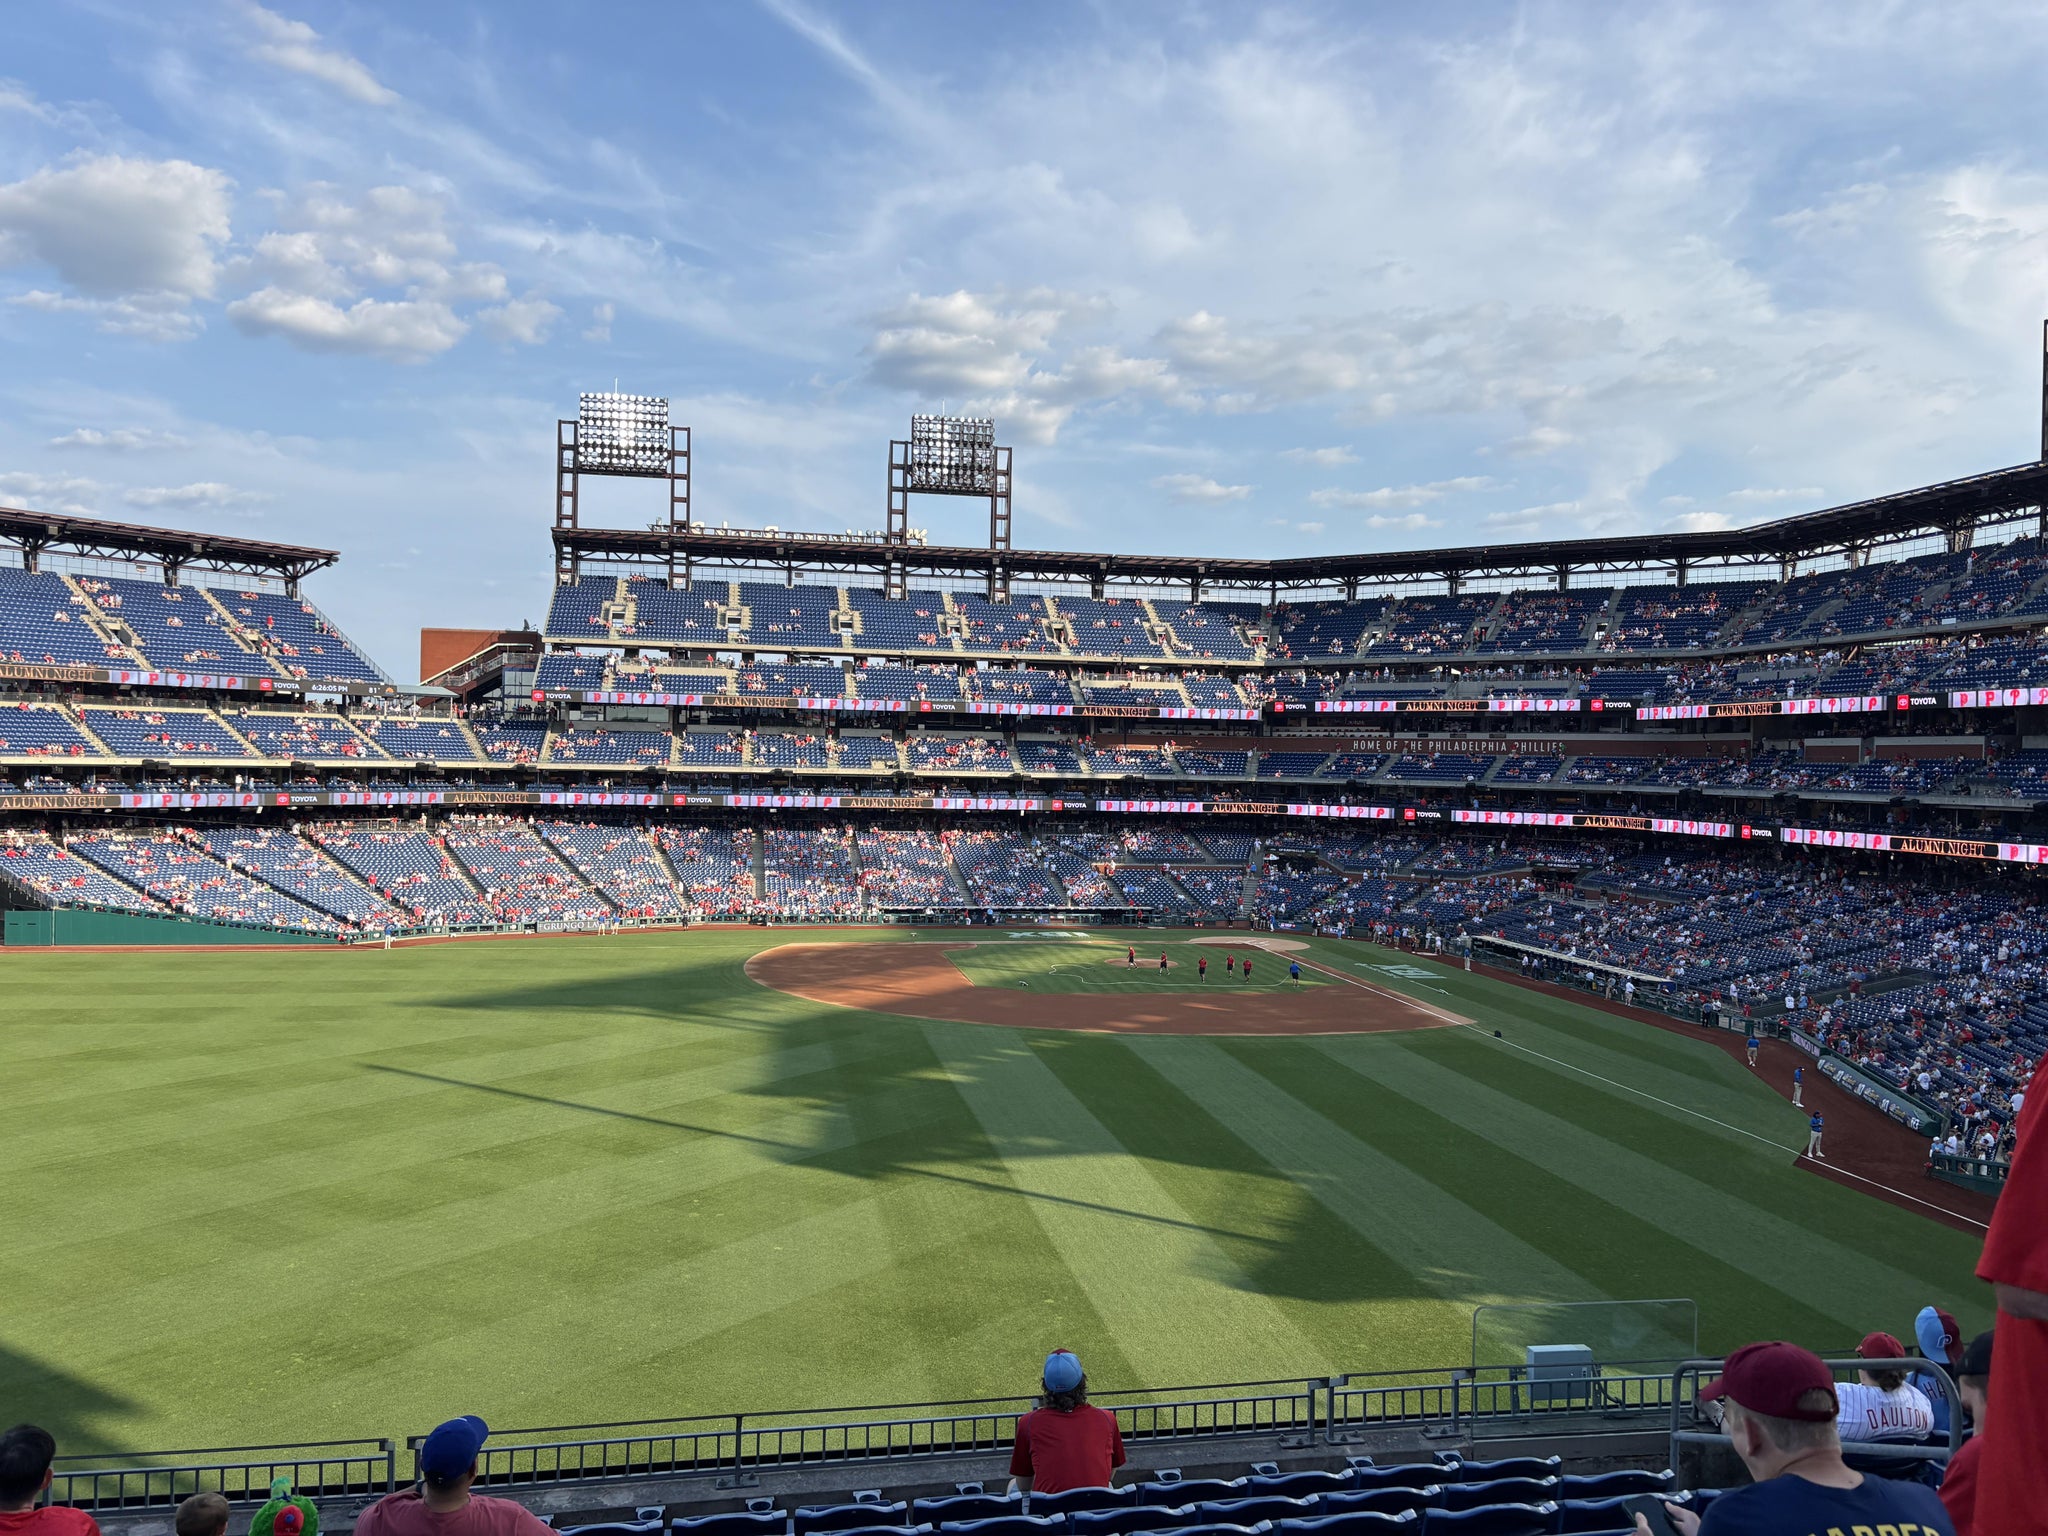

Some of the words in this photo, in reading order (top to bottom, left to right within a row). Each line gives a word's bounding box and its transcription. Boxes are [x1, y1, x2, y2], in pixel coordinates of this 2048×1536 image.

[53, 668, 95, 680] NIGHT
[274, 682, 300, 690] TOYOTA
[311, 684, 338, 692] 6:26:05
[713, 697, 754, 706] ALUMNI
[756, 698, 788, 706] NIGHT
[1604, 701, 1632, 709] TOYOTA
[1911, 697, 1937, 705] TOYOTA
[1406, 702, 1444, 710] ALUMNI
[1446, 702, 1478, 711] NIGHT
[1715, 705, 1747, 716] ALUMNI
[1748, 704, 1773, 715] NIGHT
[1082, 707, 1119, 716] ALUMNI
[1120, 708, 1150, 717] NIGHT
[1353, 740, 1381, 751] HOME
[1386, 740, 1398, 751] OF
[1428, 741, 1507, 752] PHILADELPHIA
[2, 796, 59, 808] ALUMNI
[63, 797, 106, 808] NIGHT
[453, 794, 492, 803] ALUMNI
[494, 794, 529, 803] NIGHT
[850, 799, 891, 808] ALUMNI
[892, 799, 923, 808] NIGHT
[1212, 804, 1249, 813] ALUMNI
[1250, 804, 1279, 813] NIGHT
[1416, 811, 1442, 819] TOYOTA
[1584, 816, 1624, 828] ALUMNI
[1752, 829, 1772, 837] TOYOTA
[1901, 839, 1947, 854] ALUMNI
[1948, 842, 1985, 857] NIGHT
[544, 922, 584, 930] GRUNGO
[1867, 1407, 1928, 1430] DAULTON
